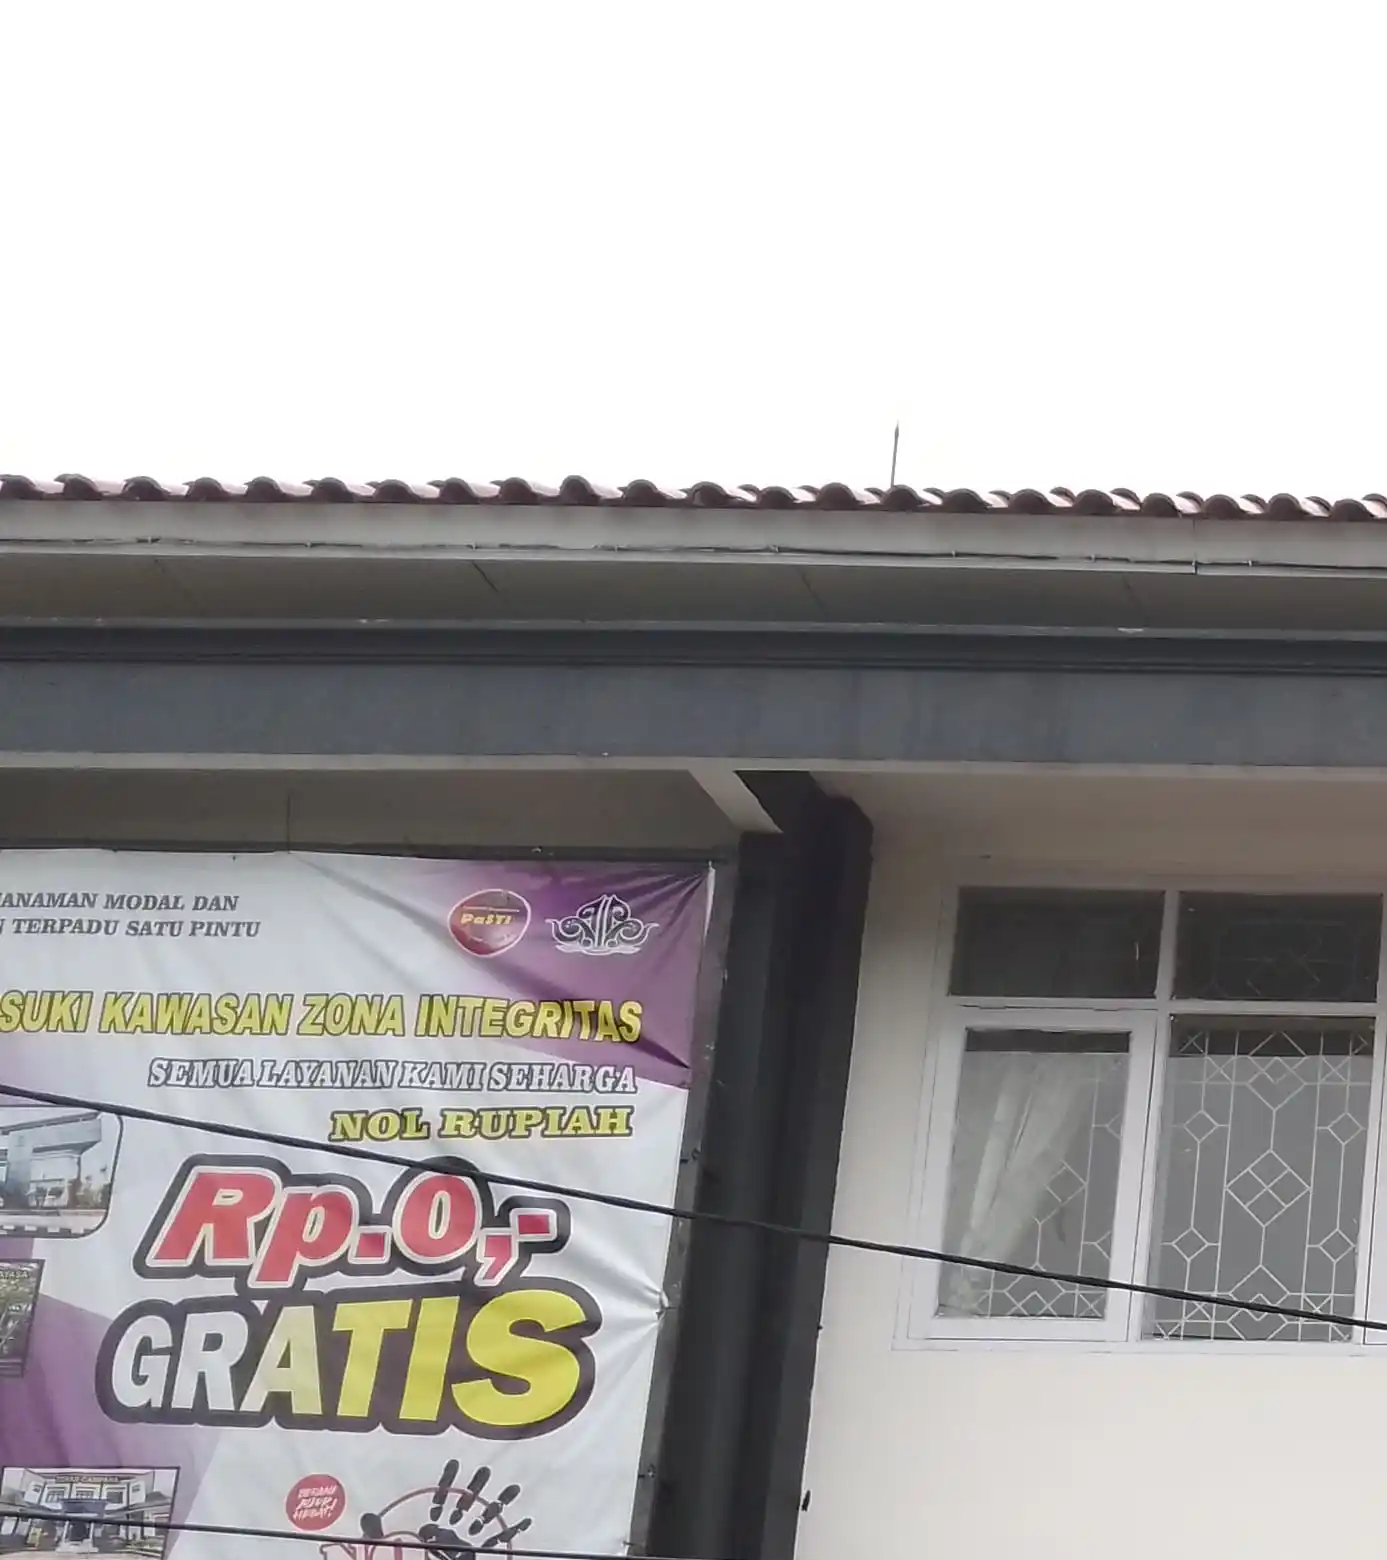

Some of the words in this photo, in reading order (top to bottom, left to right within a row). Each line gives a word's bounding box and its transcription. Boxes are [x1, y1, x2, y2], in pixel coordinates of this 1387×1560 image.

[0, 893, 98, 909] ANAMAN
[103, 894, 185, 910] MODAL
[192, 895, 239, 911] DAN
[12, 918, 120, 935] TERPADU
[125, 920, 184, 937] SATU
[188, 920, 261, 938] PINTU
[98, 991, 294, 1036] KAWASAN
[297, 993, 405, 1037] ZONA
[414, 992, 643, 1043] INTEGRITAS
[148, 1057, 256, 1088] SEMUA
[255, 1059, 399, 1090] LAYANAN
[398, 1061, 485, 1092] KAMI
[485, 1062, 637, 1095] SEHARGA
[329, 1107, 428, 1142] NOL
[439, 1105, 635, 1141] RUPIAH
[110, 1289, 588, 1427] GRATIS
